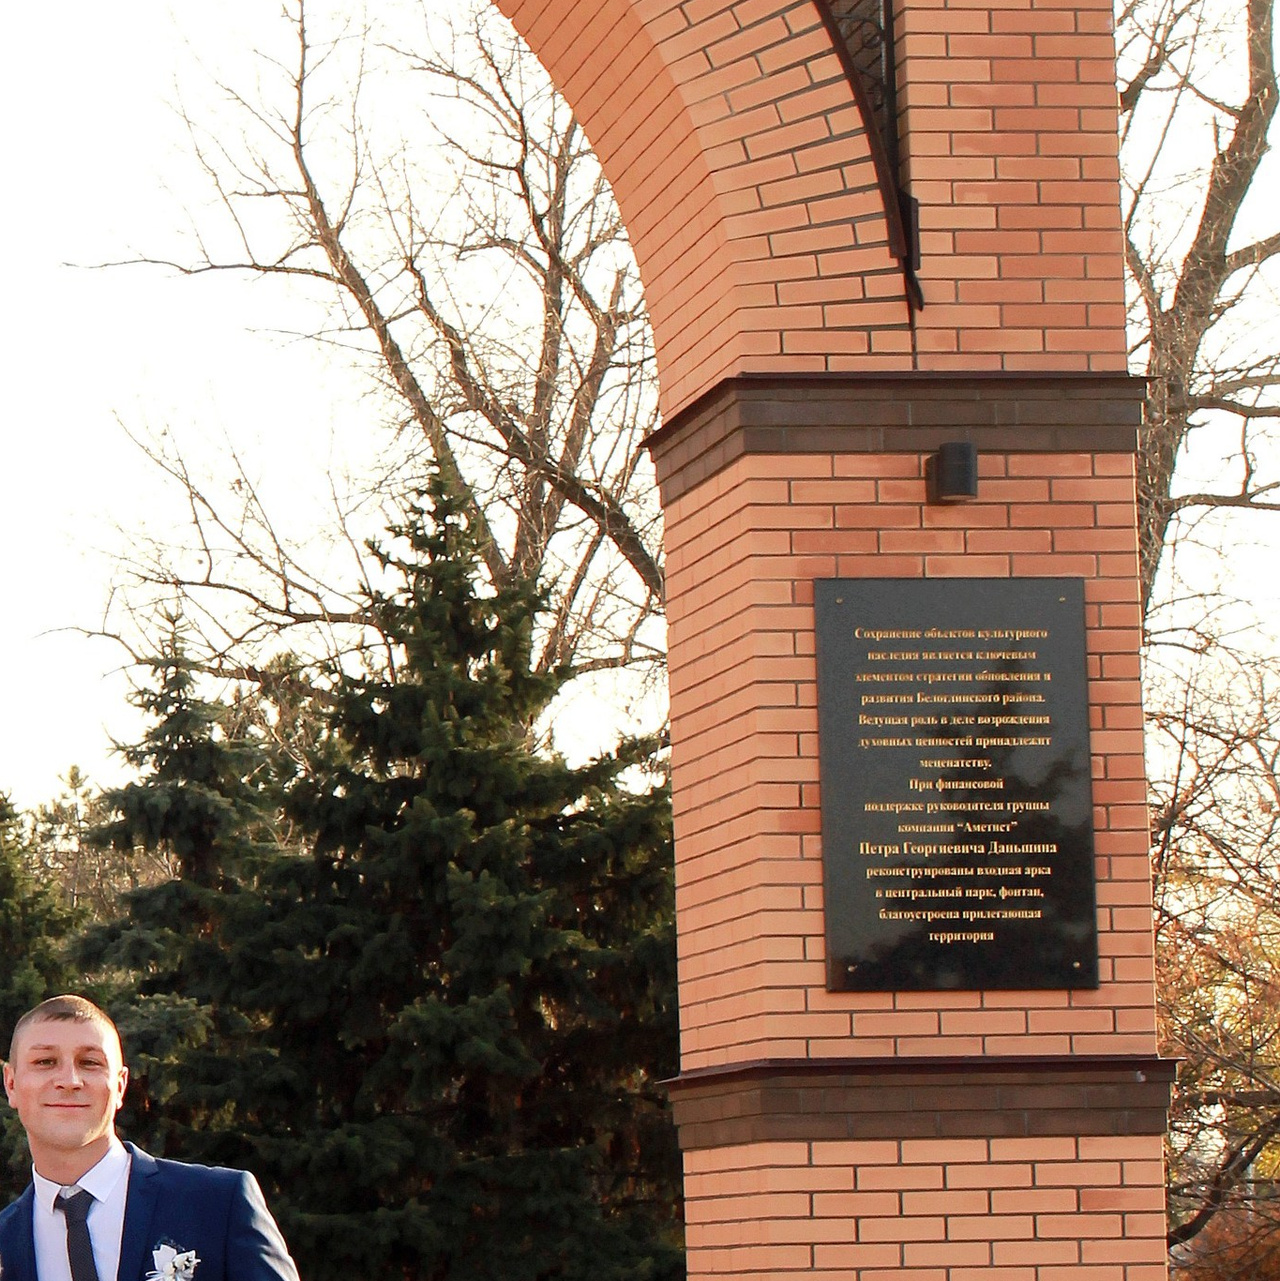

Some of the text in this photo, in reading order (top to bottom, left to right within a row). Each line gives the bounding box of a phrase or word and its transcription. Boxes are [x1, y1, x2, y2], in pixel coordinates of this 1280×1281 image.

[854, 628, 1049, 641] Сохранение объектов культурного
[867, 652, 920, 660] наследия
[921, 652, 974, 660] является
[915, 673, 973, 684] стратегии
[974, 670, 1041, 681] обновления
[1043, 673, 1052, 681] и
[861, 695, 914, 706] развития
[916, 692, 1001, 703] Белоглинского
[858, 714, 909, 727] Ведущая
[910, 717, 939, 727] роль
[949, 716, 976, 725] деле
[915, 735, 974, 747] ценностей
[975, 737, 1052, 748] принадлежит
[909, 778, 1005, 792] При финансовой
[864, 802, 1050, 814] поддержке руководителя группы
[897, 824, 956, 832] компании
[859, 841, 1058, 857] Петра Георгиевича Даньшина
[866, 867, 1052, 879] реконструированы входная арка
[884, 887, 963, 900] центральный
[878, 909, 1041, 922] благоустроена прилегающая
[927, 932, 995, 944] территория
